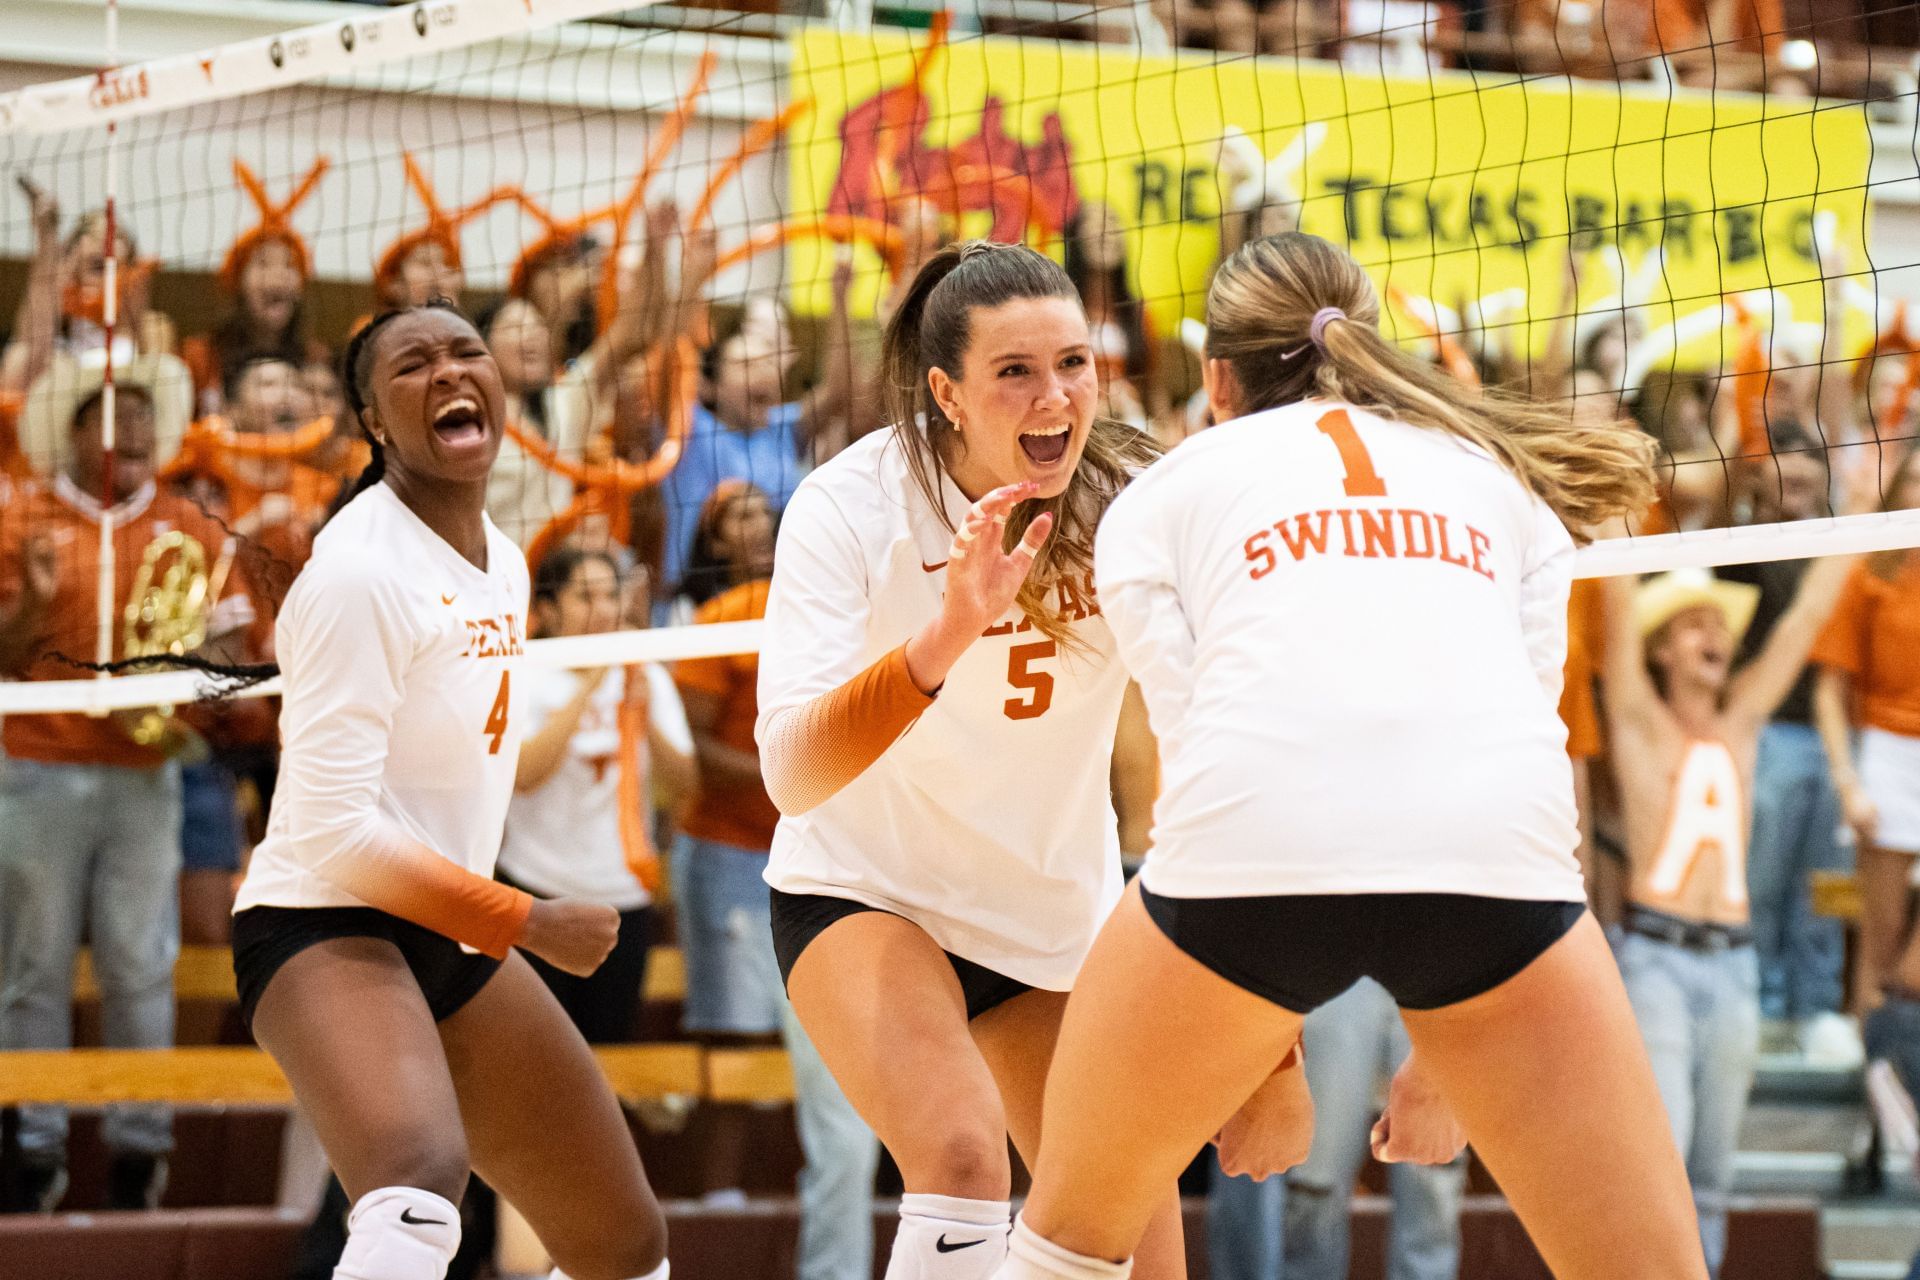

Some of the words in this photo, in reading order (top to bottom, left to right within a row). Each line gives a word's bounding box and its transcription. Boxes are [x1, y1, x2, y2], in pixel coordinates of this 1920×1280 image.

[1134, 162, 1214, 225] RE
[1323, 175, 1540, 251] TEXAS
[1315, 408, 1388, 497] 1
[1244, 508, 1495, 582] SWINDLE
[460, 613, 524, 658] TEXA
[484, 669, 510, 755] 4
[1003, 639, 1056, 720] 5
[1650, 740, 1746, 903] A
